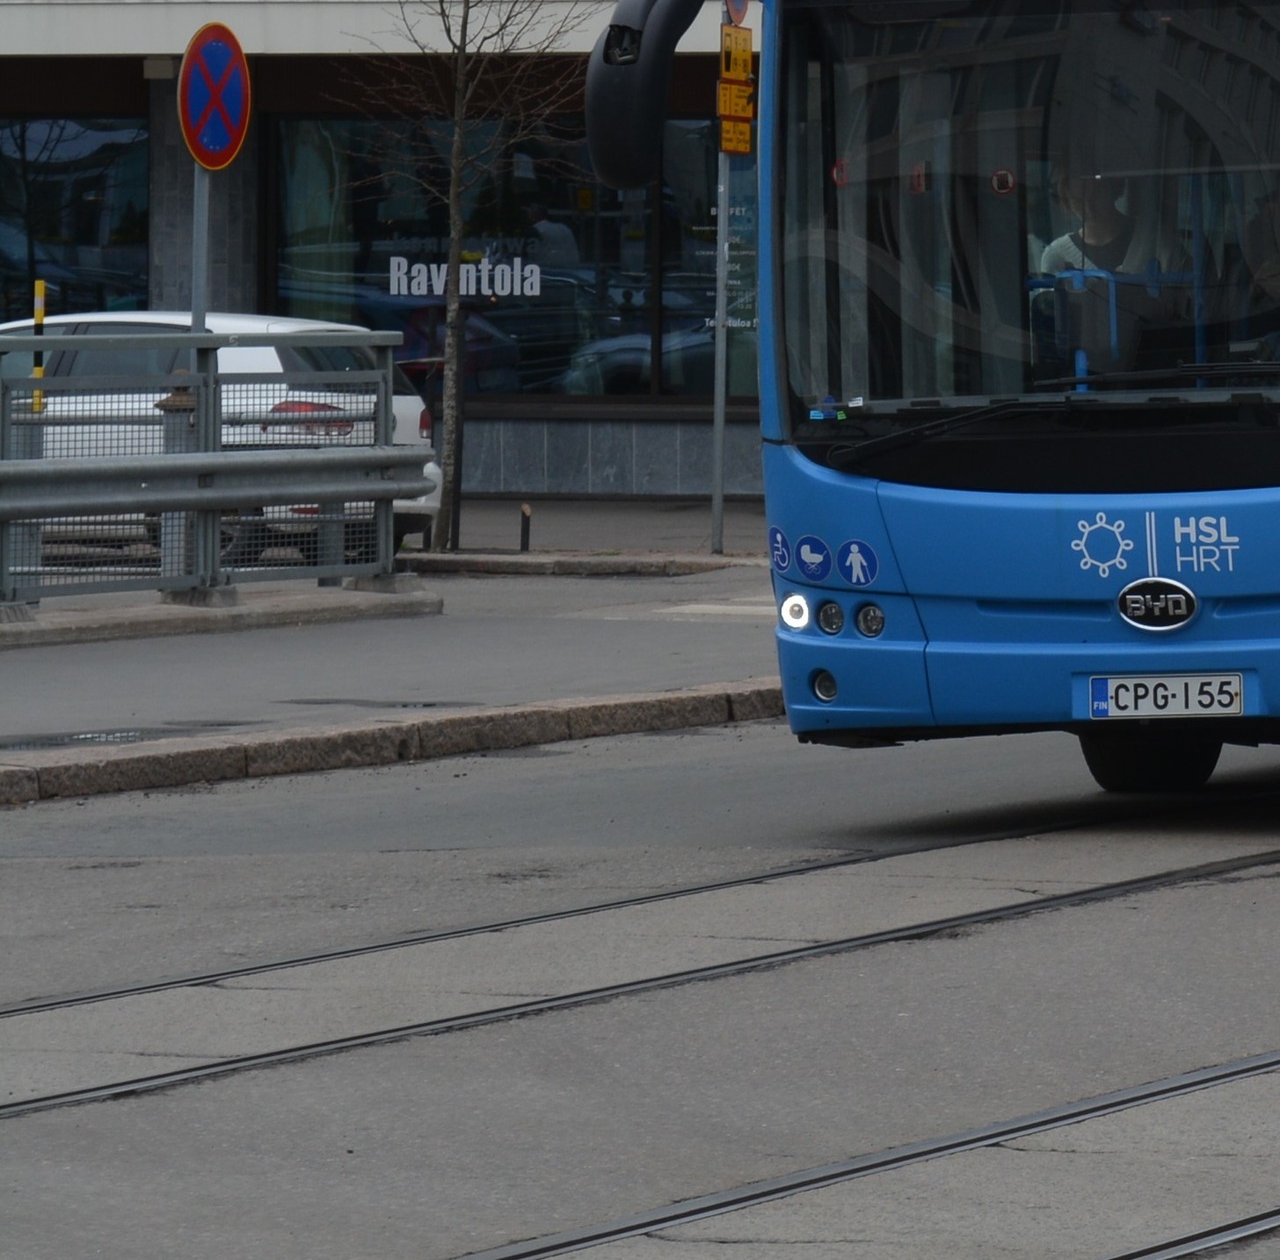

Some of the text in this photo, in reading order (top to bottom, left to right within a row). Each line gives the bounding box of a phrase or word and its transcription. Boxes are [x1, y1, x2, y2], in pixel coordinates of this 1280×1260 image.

[389, 256, 541, 296] Ravntola
[1174, 516, 1240, 543] HSL
[1175, 544, 1240, 572] HRT
[1126, 594, 1188, 616] BYD
[1093, 681, 1235, 711] FIN CPG-155
